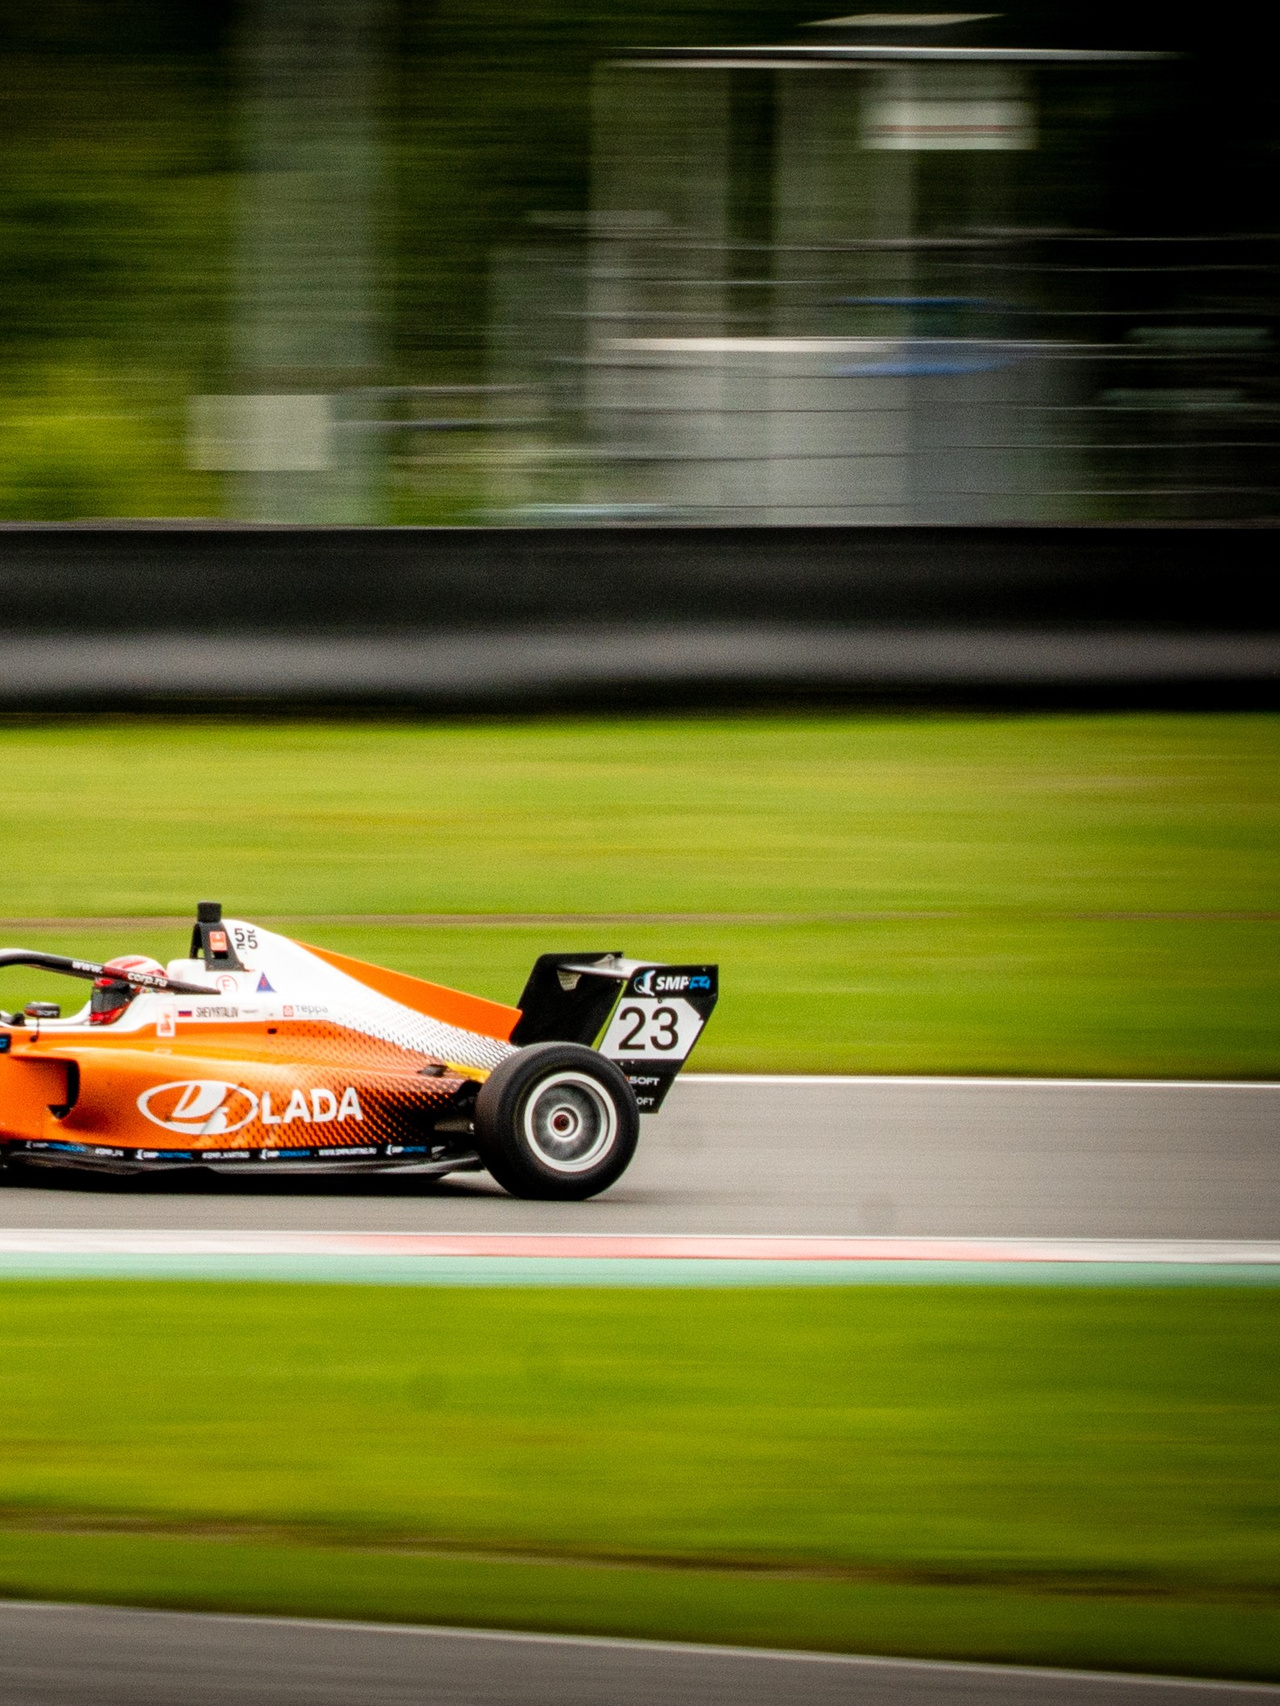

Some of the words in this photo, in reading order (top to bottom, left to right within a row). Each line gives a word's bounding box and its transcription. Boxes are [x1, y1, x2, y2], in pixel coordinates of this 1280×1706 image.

[618, 1006, 679, 1051] 23
[261, 1086, 364, 1125] LADA
[635, 1097, 655, 1106] OFT
